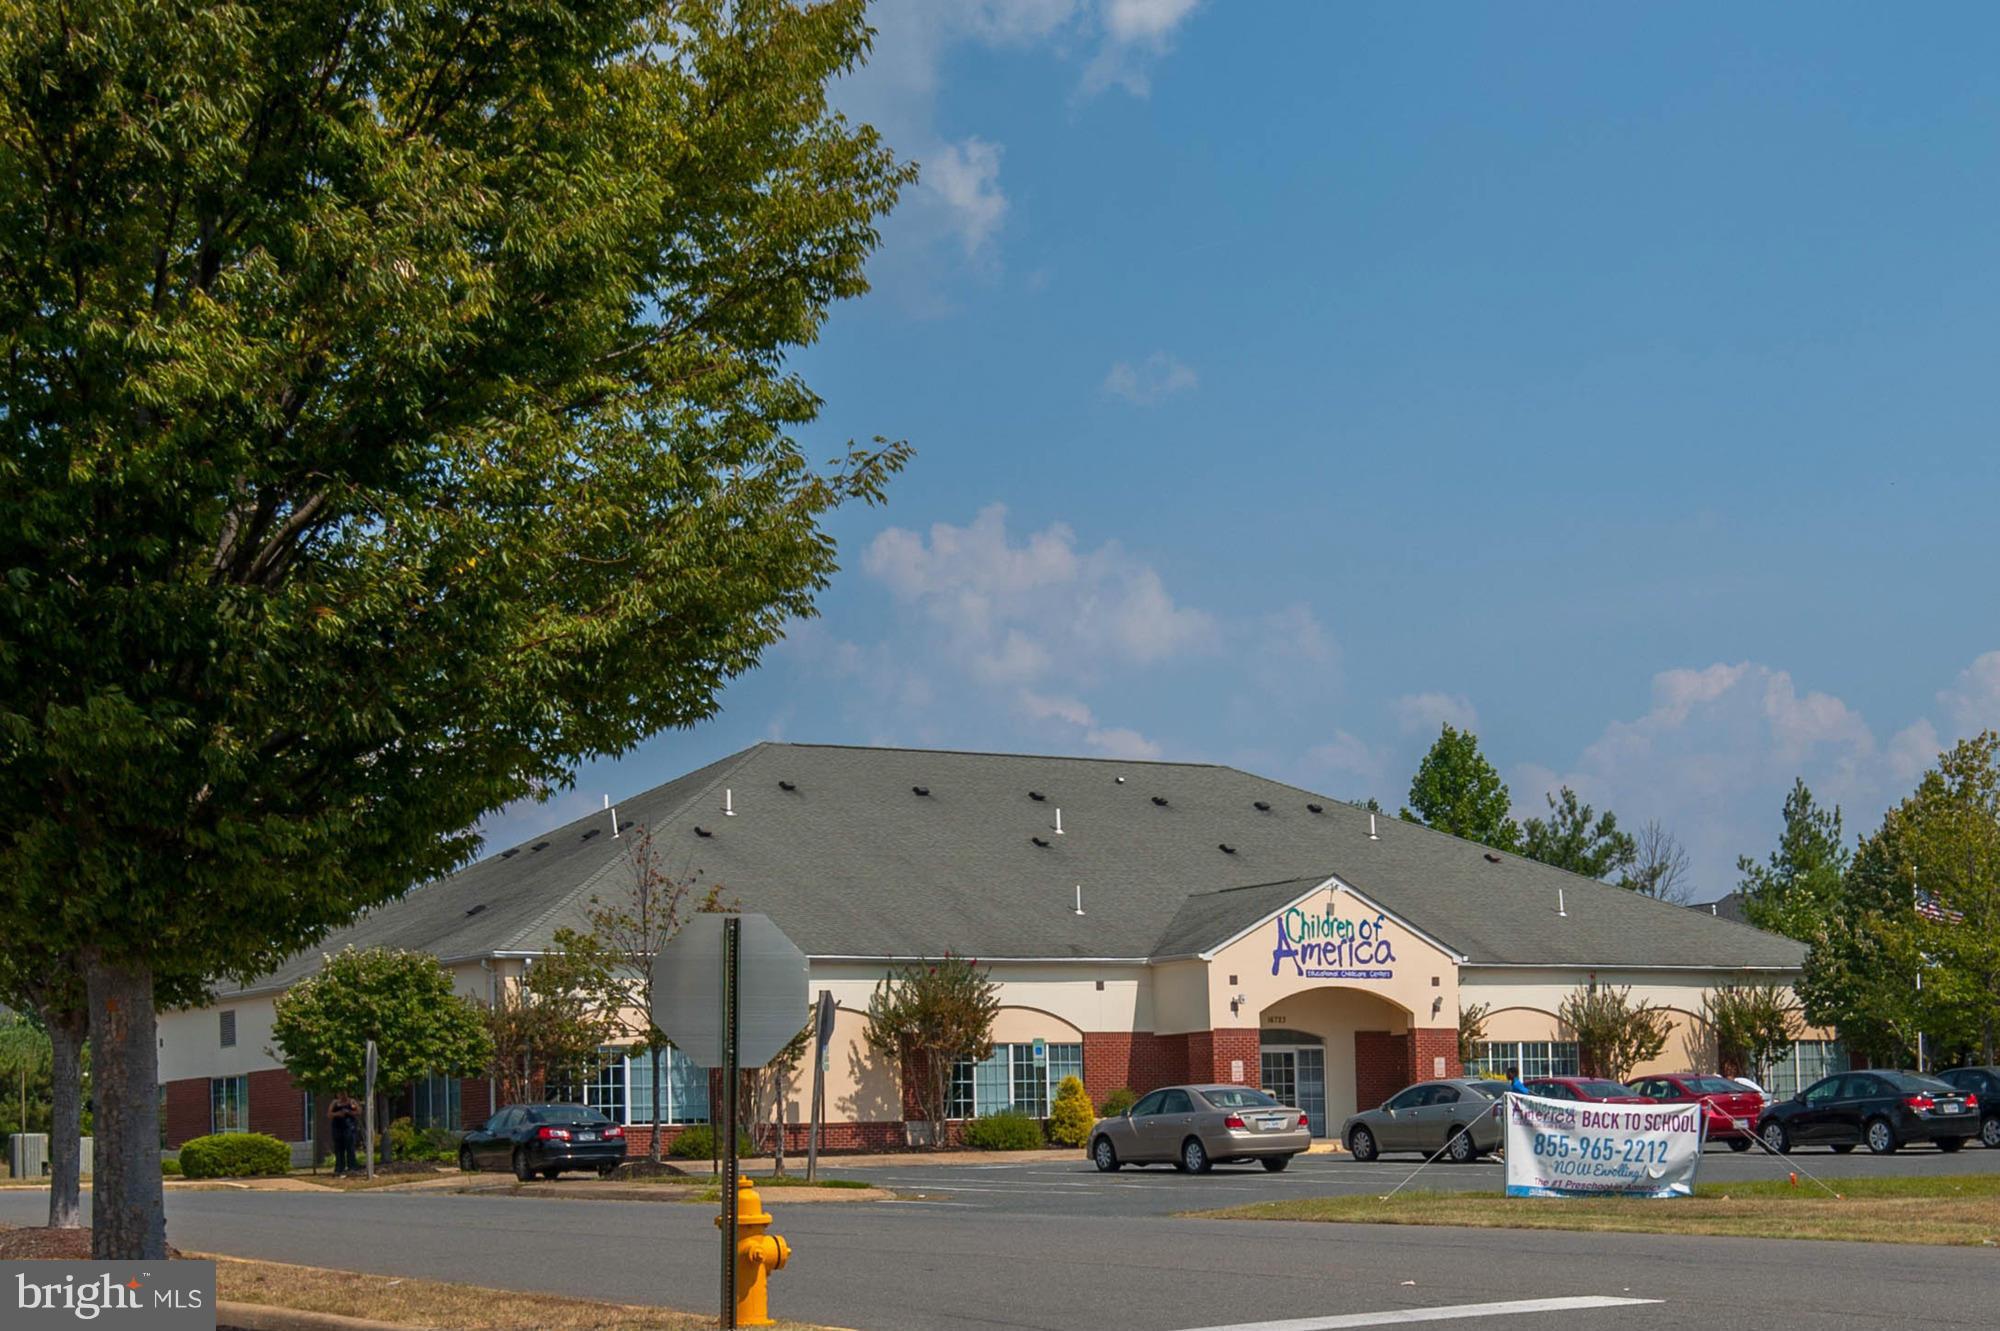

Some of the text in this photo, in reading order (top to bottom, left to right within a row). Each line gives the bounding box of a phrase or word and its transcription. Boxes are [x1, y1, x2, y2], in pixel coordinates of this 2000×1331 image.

[1286, 907, 1385, 943] Children of
[1272, 917, 1396, 976] America
[1582, 1110, 1620, 1130] BACK
[1625, 1113, 1642, 1131] TO
[1644, 1113, 1697, 1133] SCHOOL
[1534, 1132, 1669, 1164] 855-965-2212
[1535, 1177, 1549, 1187] The
